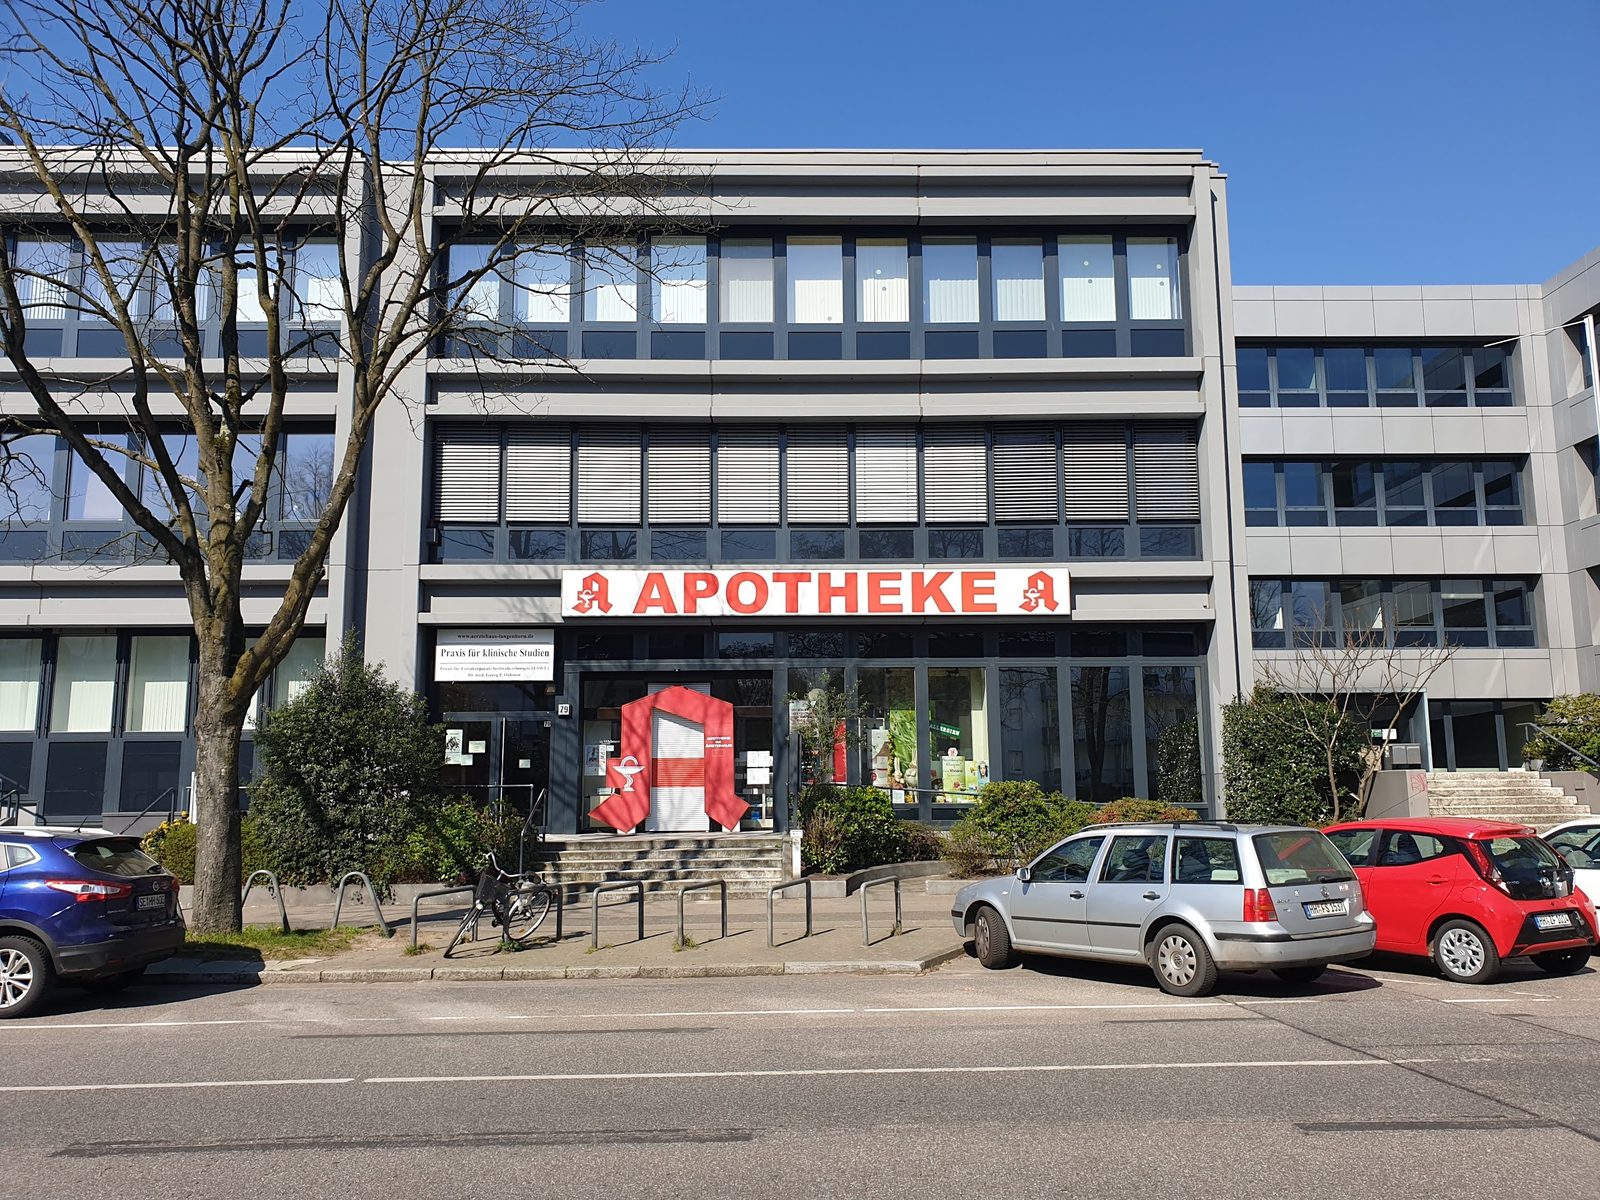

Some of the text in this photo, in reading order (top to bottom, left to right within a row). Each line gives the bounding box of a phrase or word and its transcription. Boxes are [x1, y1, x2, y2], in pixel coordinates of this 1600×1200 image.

[632, 571, 998, 614] APOTHEKE
[441, 648, 550, 658] Praxis für klinische Studien
[560, 705, 569, 714] 79
